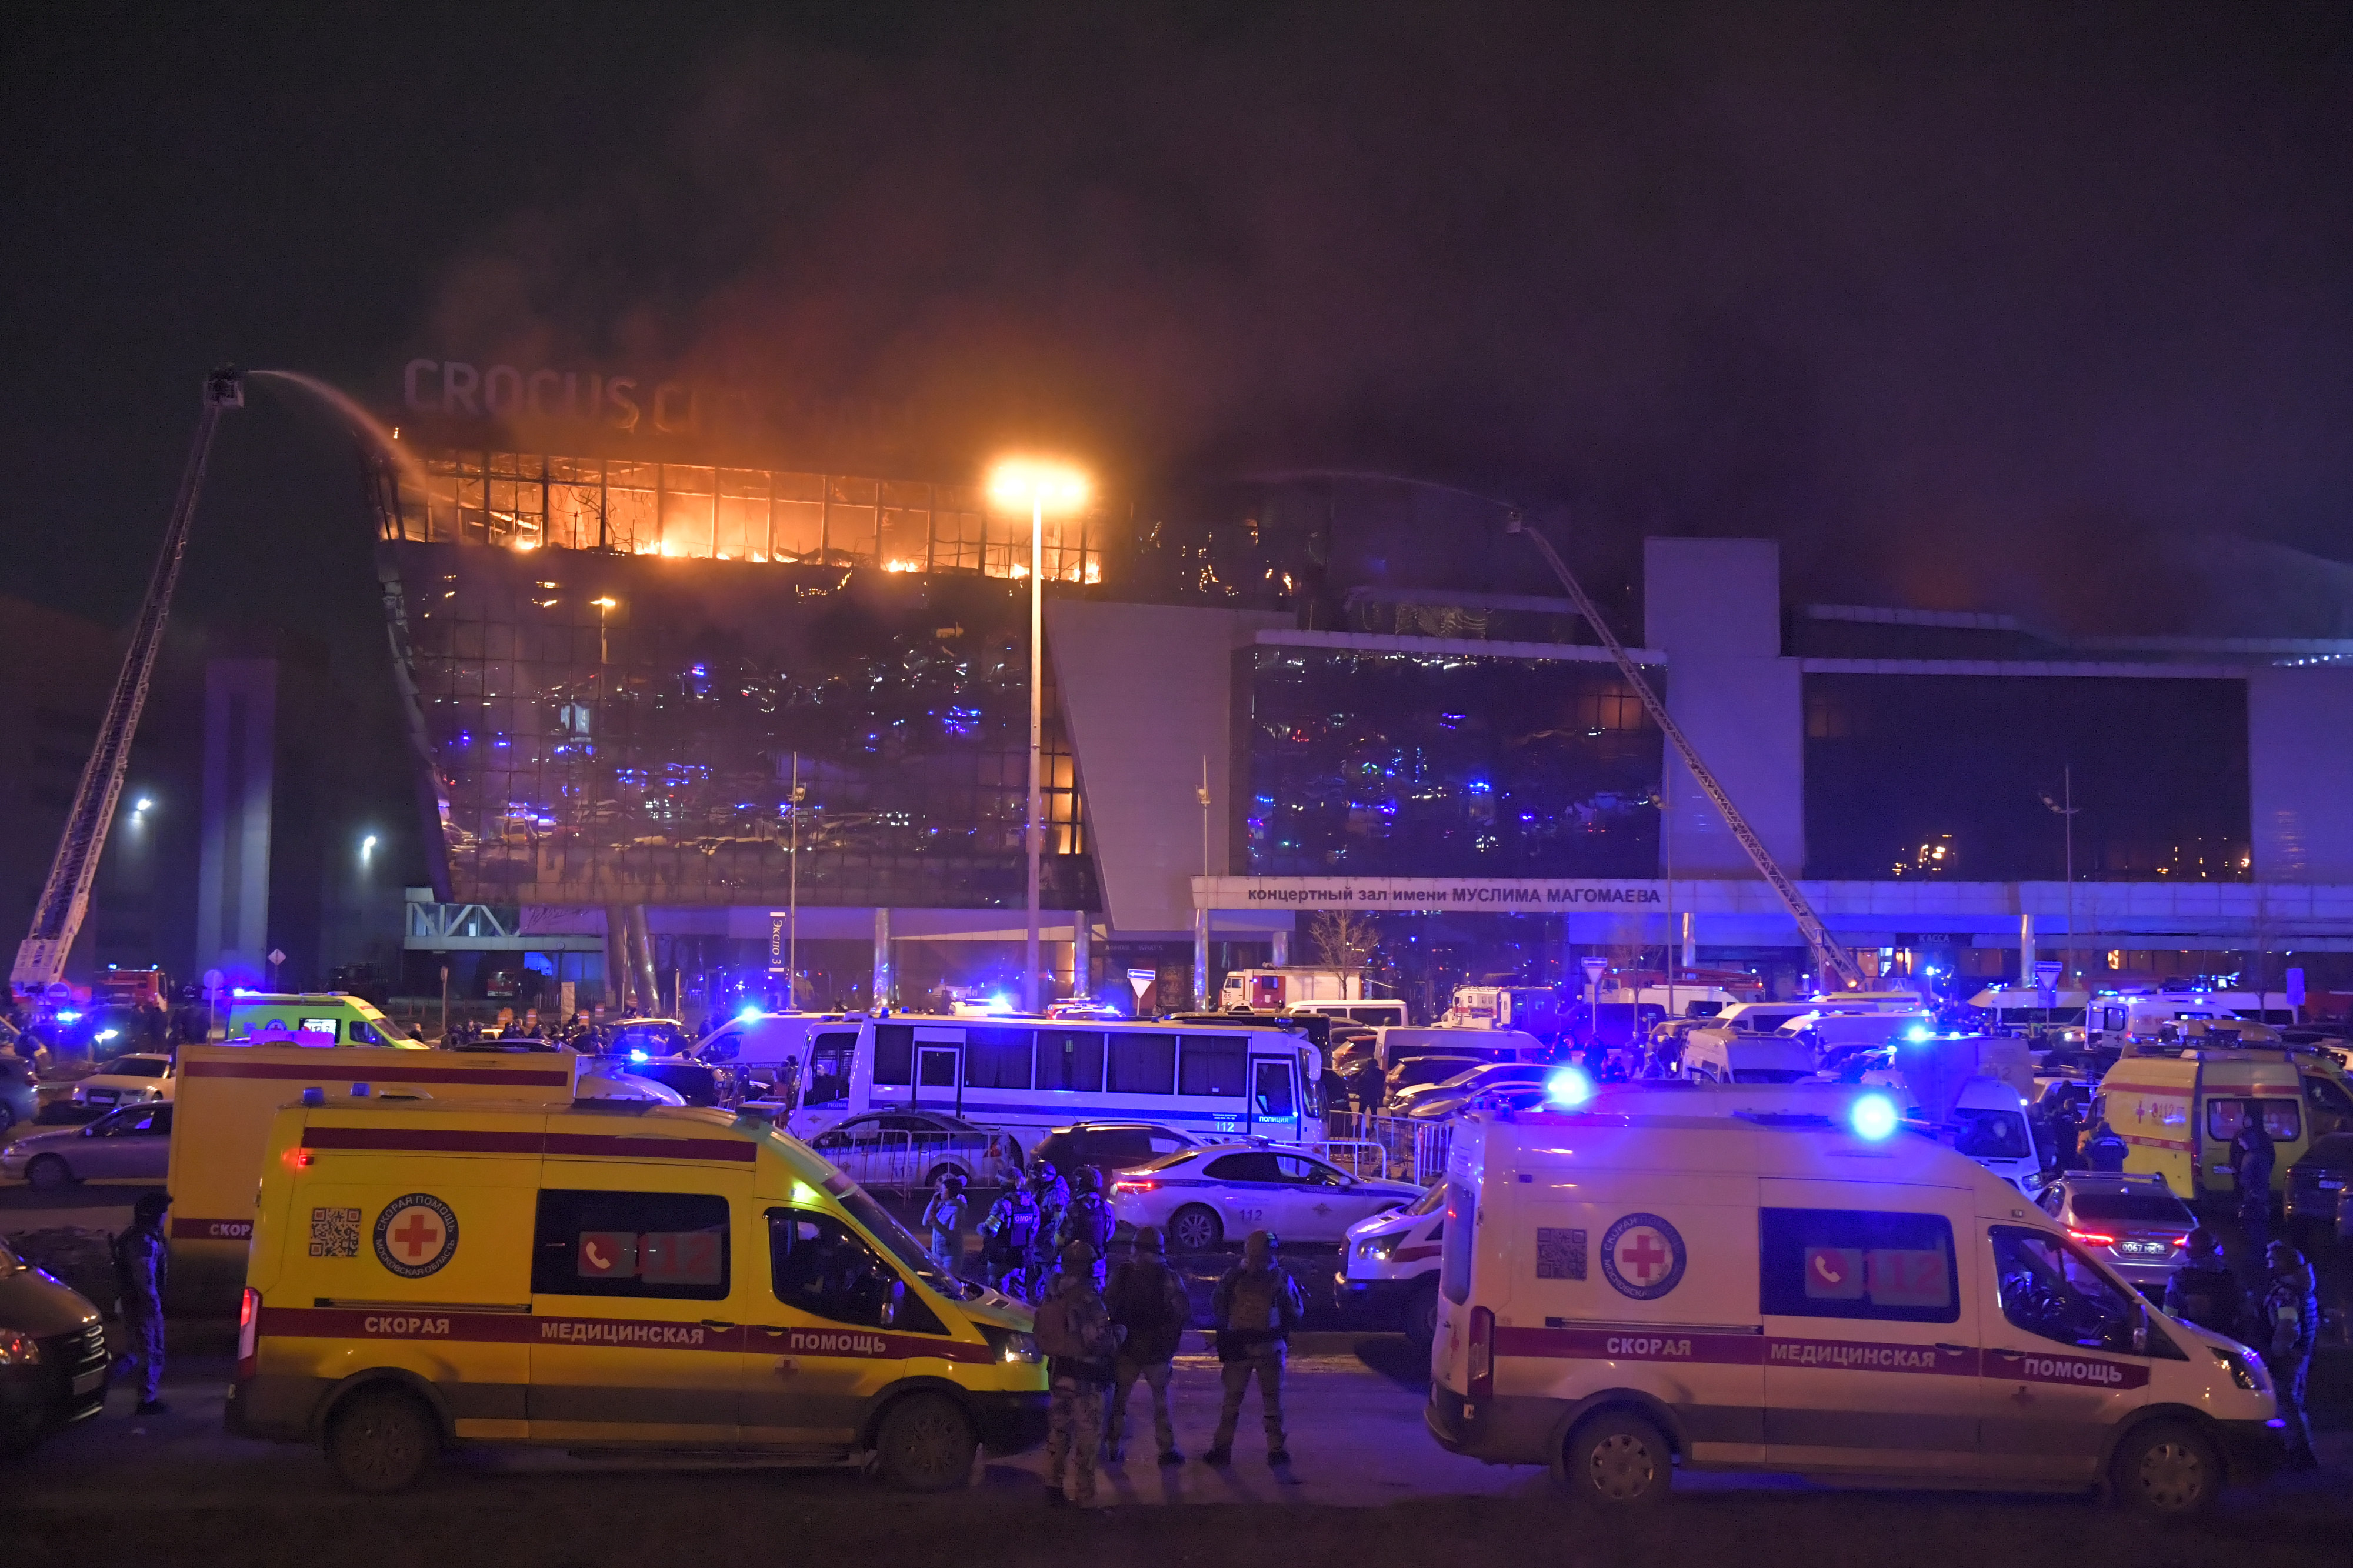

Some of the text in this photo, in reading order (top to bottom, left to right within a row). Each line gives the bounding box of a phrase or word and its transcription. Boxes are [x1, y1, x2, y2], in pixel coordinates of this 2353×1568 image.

[404, 358, 638, 433] CROCUS
[1248, 887, 1661, 903] концертный зал имени МУСЛИМА МАГОМАЕВА
[772, 919, 782, 955] Экспо
[1919, 934, 1950, 943] КАССА
[1215, 1122, 1234, 1132] 112
[210, 1223, 252, 1236] СКОР
[378, 1196, 455, 1232] СКОРАЯ ПОМОЩЬ
[1239, 1209, 1262, 1222] 112
[376, 1239, 455, 1275] МОСКОВСКАЯ ОБЛАСТЬ
[633, 1233, 715, 1276] 112
[1864, 1252, 1942, 1295] 112
[365, 1317, 886, 1355] СКОРАЯ МЕДИЦИНСКАЯ ПОМОЩЬ
[1607, 1337, 2122, 1384] СКОРАЯ МЕДИЦИНСКАЯ ПОМОЩЬ
